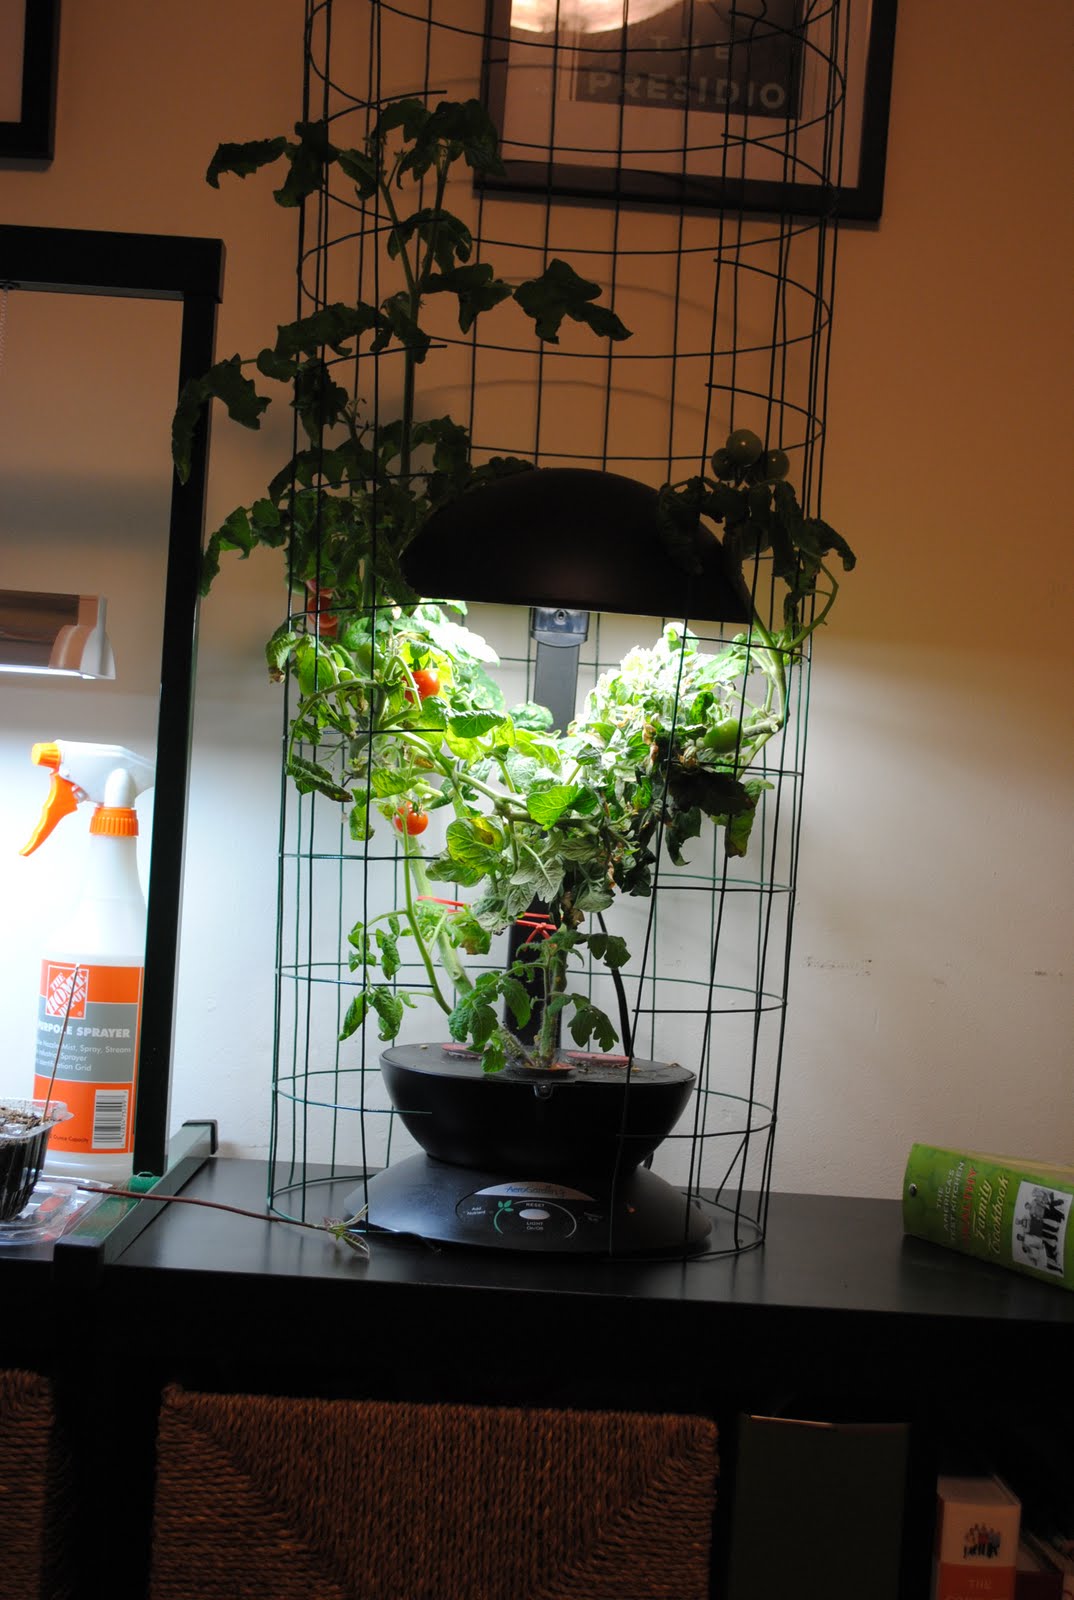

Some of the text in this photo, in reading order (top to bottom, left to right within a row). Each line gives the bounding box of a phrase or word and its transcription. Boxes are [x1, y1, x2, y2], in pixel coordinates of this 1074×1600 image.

[653, 36, 730, 60] THE
[588, 74, 786, 109] PRESIDIO
[47, 969, 88, 1015] HOME
[50, 972, 66, 990] THE
[58, 987, 86, 1016] DEPOT
[76, 1026, 131, 1038] SPRAYER
[60, 1053, 87, 1063] Sprayer
[80, 1045, 103, 1055] Spray,
[105, 1046, 131, 1054] Stream
[75, 1063, 92, 1072] Grid
[936, 1186, 944, 1209] THE
[951, 1161, 966, 1212] KITCHEN
[943, 1168, 955, 1232] AMERICA'S
[972, 1179, 993, 1240] Family
[987, 1174, 1010, 1254] Cookbook
